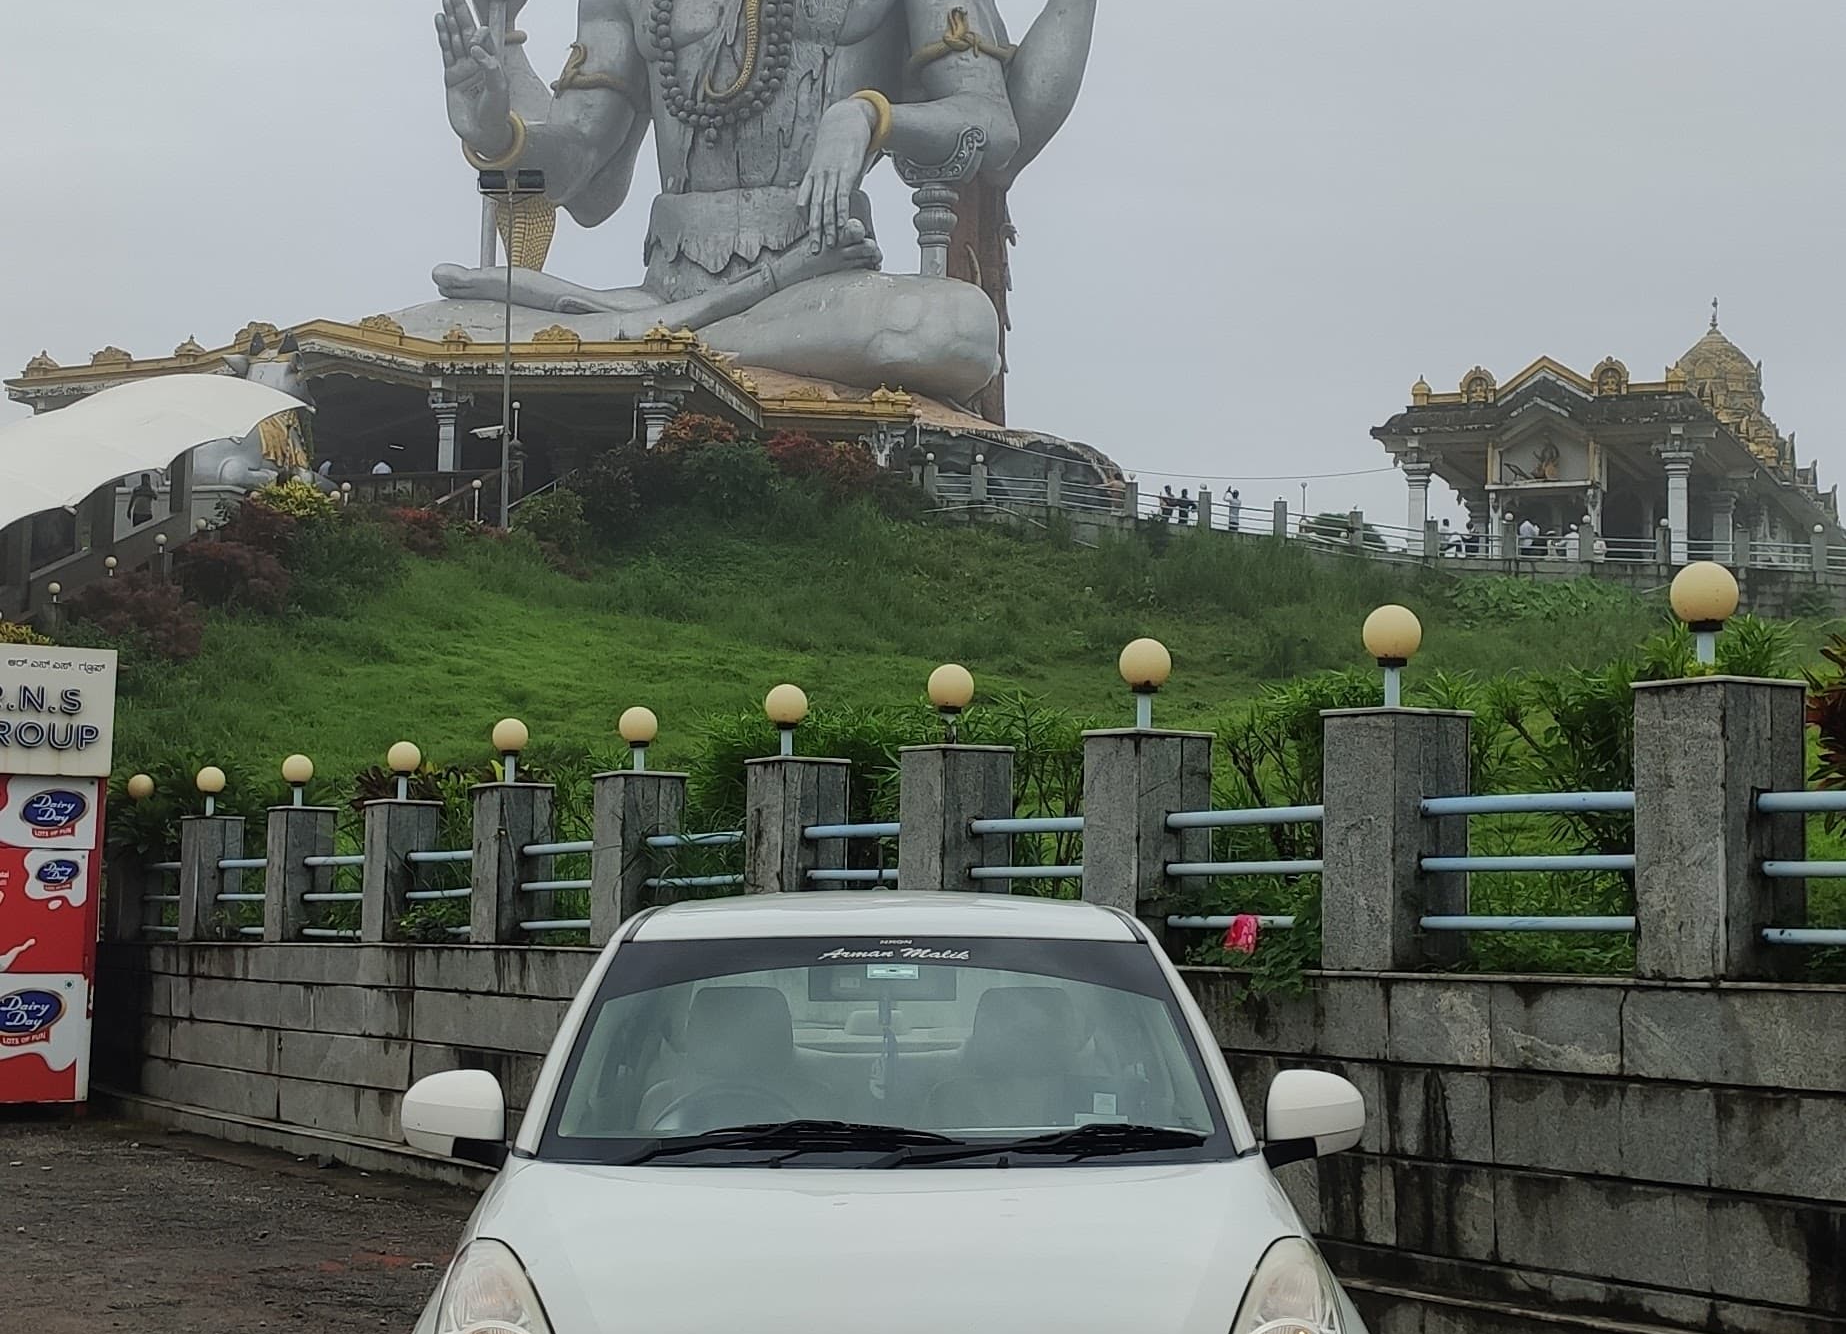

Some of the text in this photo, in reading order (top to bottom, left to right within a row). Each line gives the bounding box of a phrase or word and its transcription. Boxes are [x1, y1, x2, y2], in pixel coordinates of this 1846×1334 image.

[32, 793, 76, 814] Dairy
[37, 807, 69, 827] Day
[817, 947, 971, 960] Arman Malik
[0, 995, 50, 1017] Dairy
[5, 1010, 43, 1031] Day
[2, 1037, 20, 1045] LOTS
[31, 1032, 46, 1041] FUN
